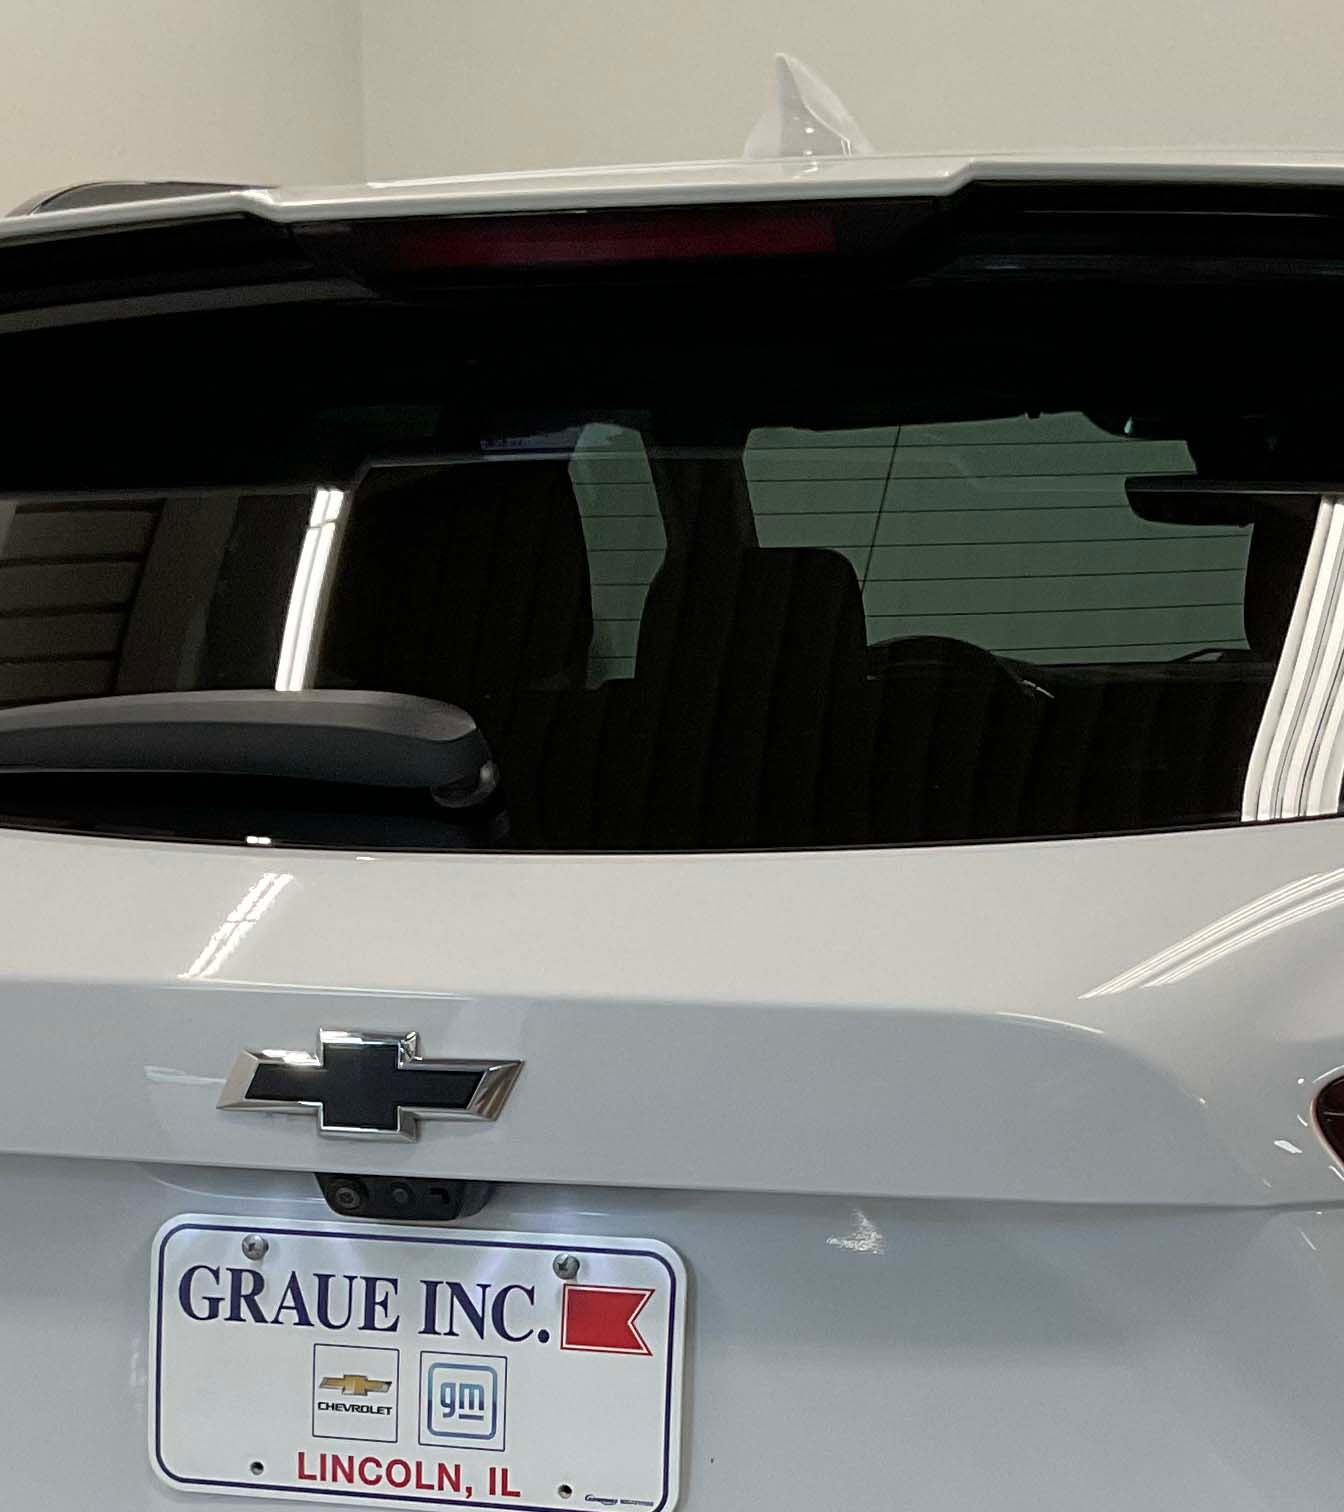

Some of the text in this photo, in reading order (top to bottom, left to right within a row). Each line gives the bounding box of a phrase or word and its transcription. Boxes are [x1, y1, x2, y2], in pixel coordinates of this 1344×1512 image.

[178, 1264, 551, 1344] GRAUE INC.
[317, 1401, 393, 1416] CHEVROLET
[440, 1382, 485, 1421] gm
[297, 1452, 521, 1499] LINCOLN, IL
